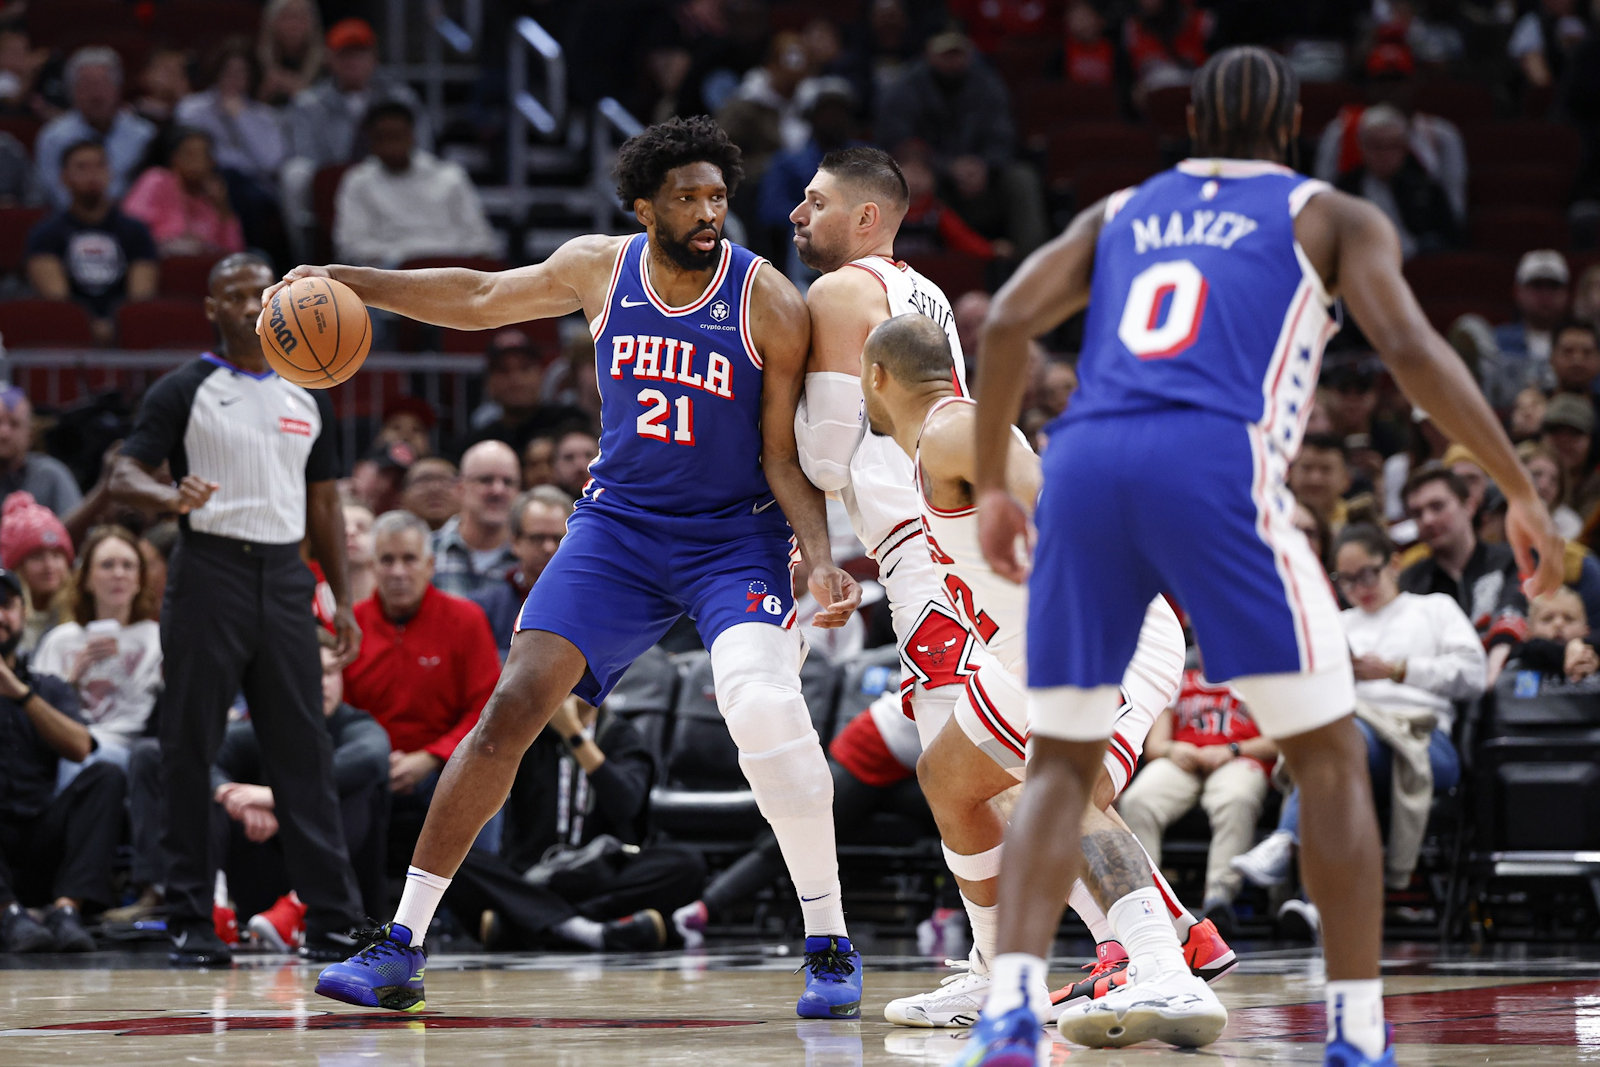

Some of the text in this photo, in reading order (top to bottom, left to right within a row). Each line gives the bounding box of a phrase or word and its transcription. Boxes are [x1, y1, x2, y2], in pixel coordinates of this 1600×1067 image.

[1131, 209, 1259, 255] MAXEY
[700, 323, 737, 332] crypto.com
[1117, 258, 1210, 362] 0
[610, 334, 735, 401] PHILA
[636, 387, 696, 447] 21
[745, 592, 782, 616] 76
